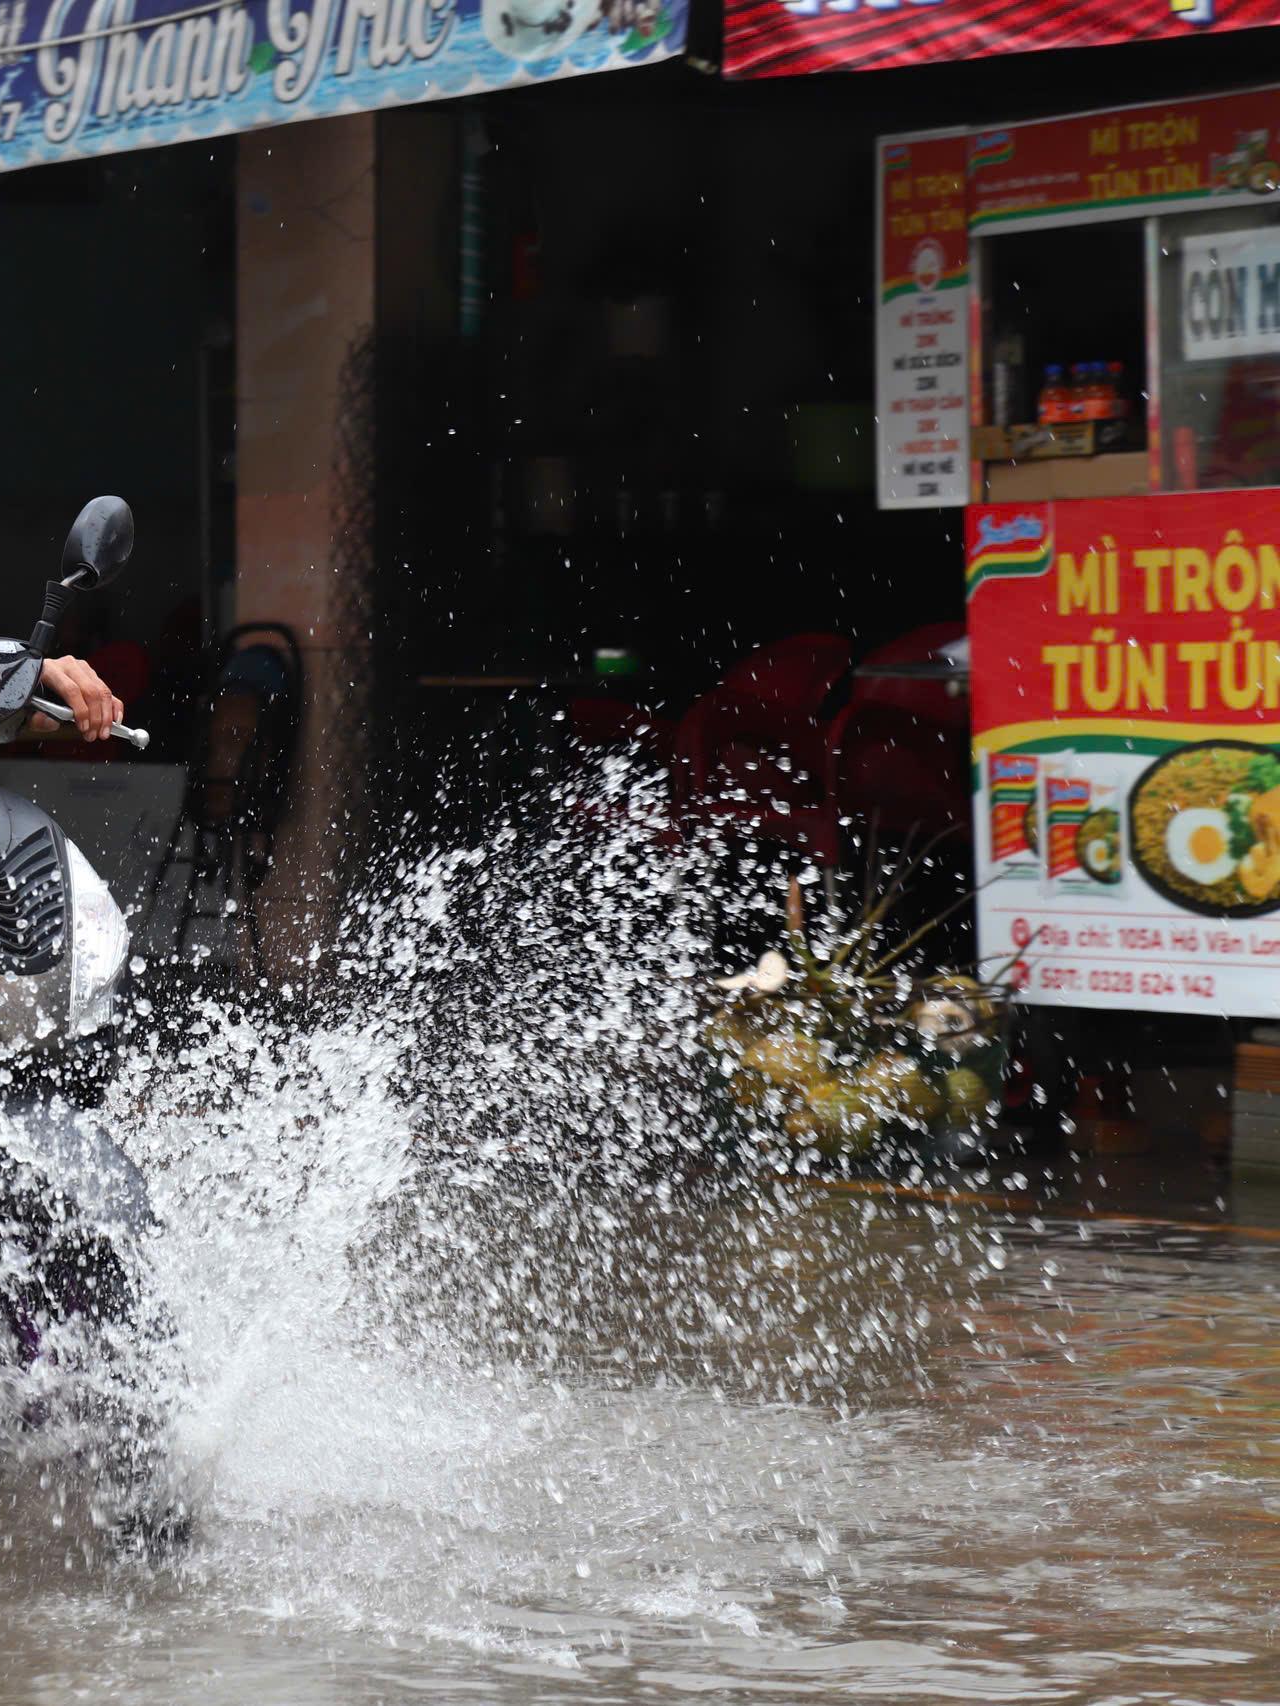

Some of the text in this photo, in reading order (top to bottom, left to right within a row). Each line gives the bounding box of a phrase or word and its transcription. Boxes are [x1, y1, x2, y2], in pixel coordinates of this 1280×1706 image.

[1057, 534, 1119, 616] MÌ
[1041, 627, 1166, 712] TŨN
[1118, 927, 1164, 950] 105A
[1089, 969, 1134, 993] 0328
[1140, 972, 1176, 996] 624
[1181, 974, 1216, 999] 142
